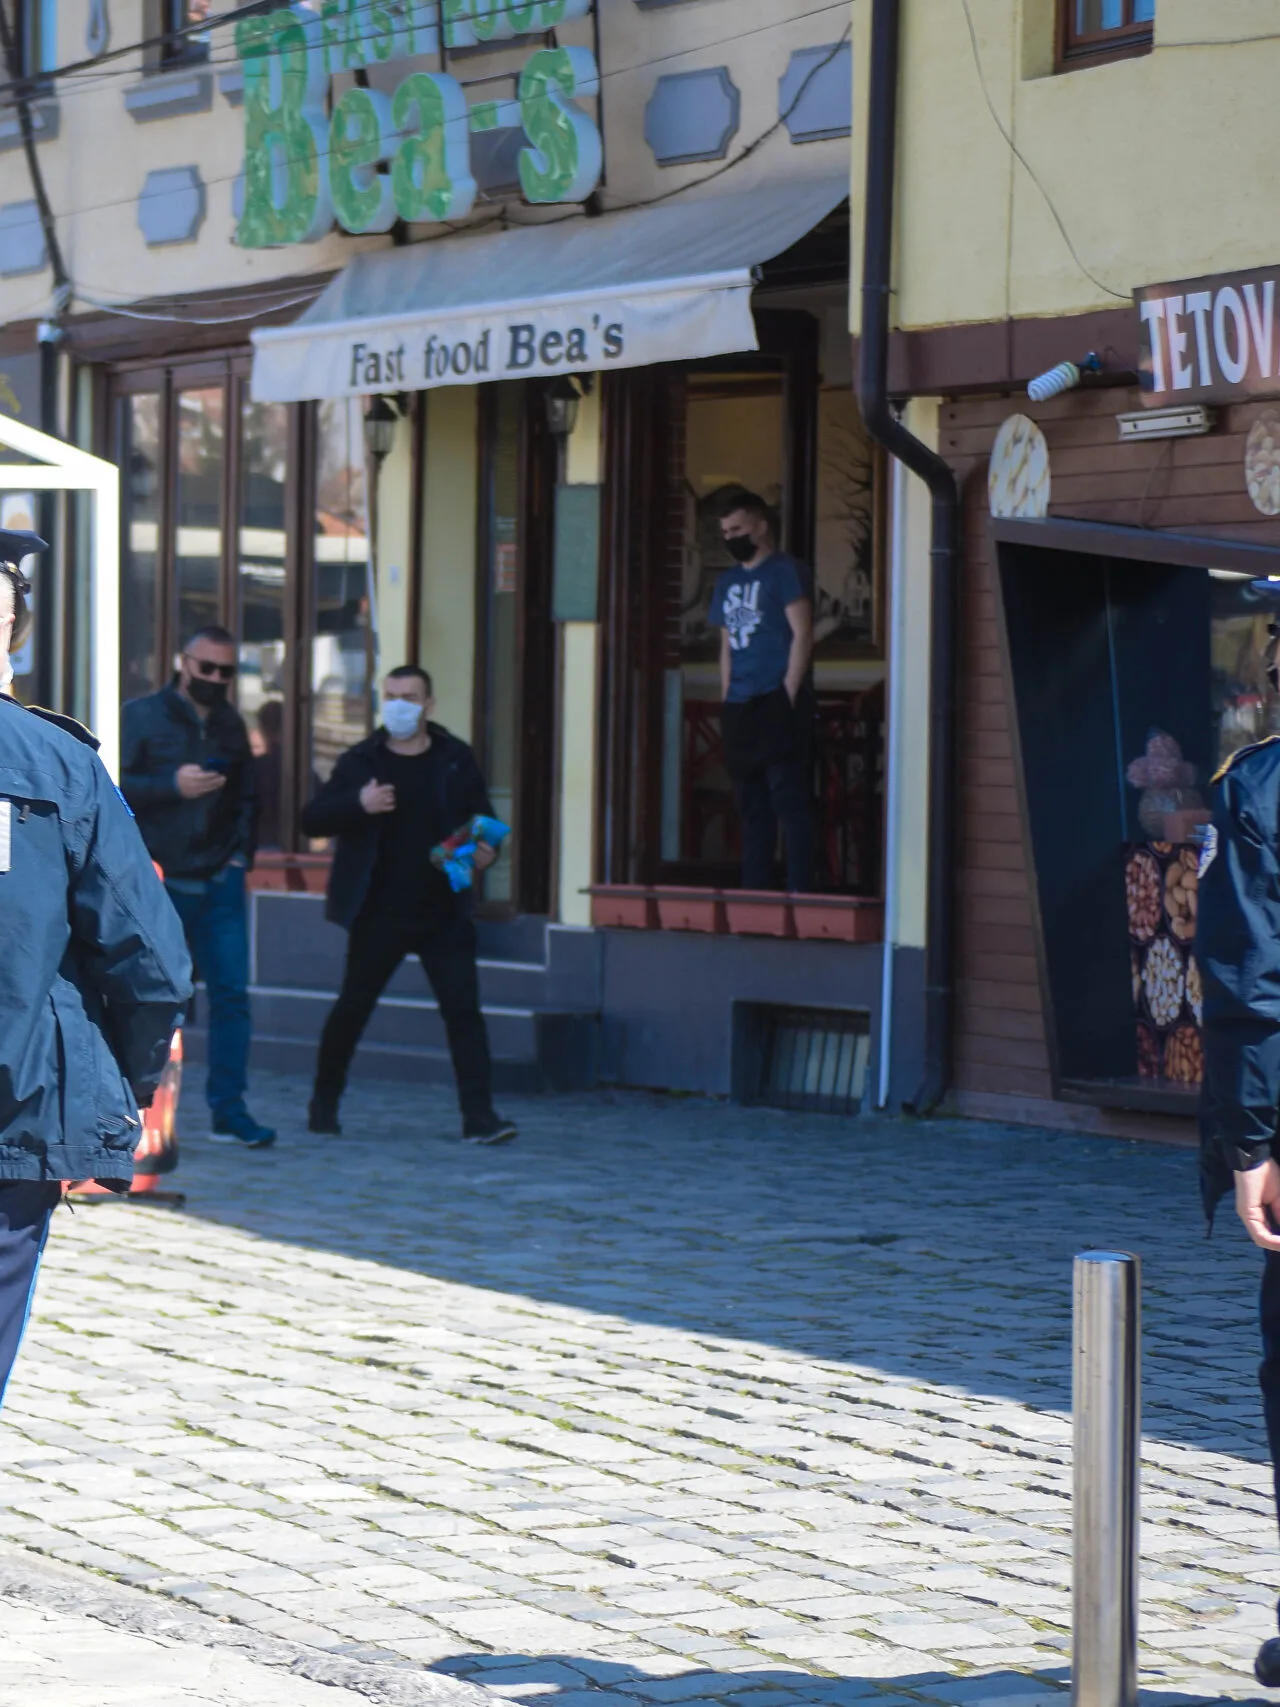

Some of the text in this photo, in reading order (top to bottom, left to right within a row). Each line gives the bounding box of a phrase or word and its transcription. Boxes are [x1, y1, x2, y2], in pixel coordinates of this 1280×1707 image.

[350, 313, 624, 387] Fast food Bea's
[1140, 281, 1280, 393] TETOV
